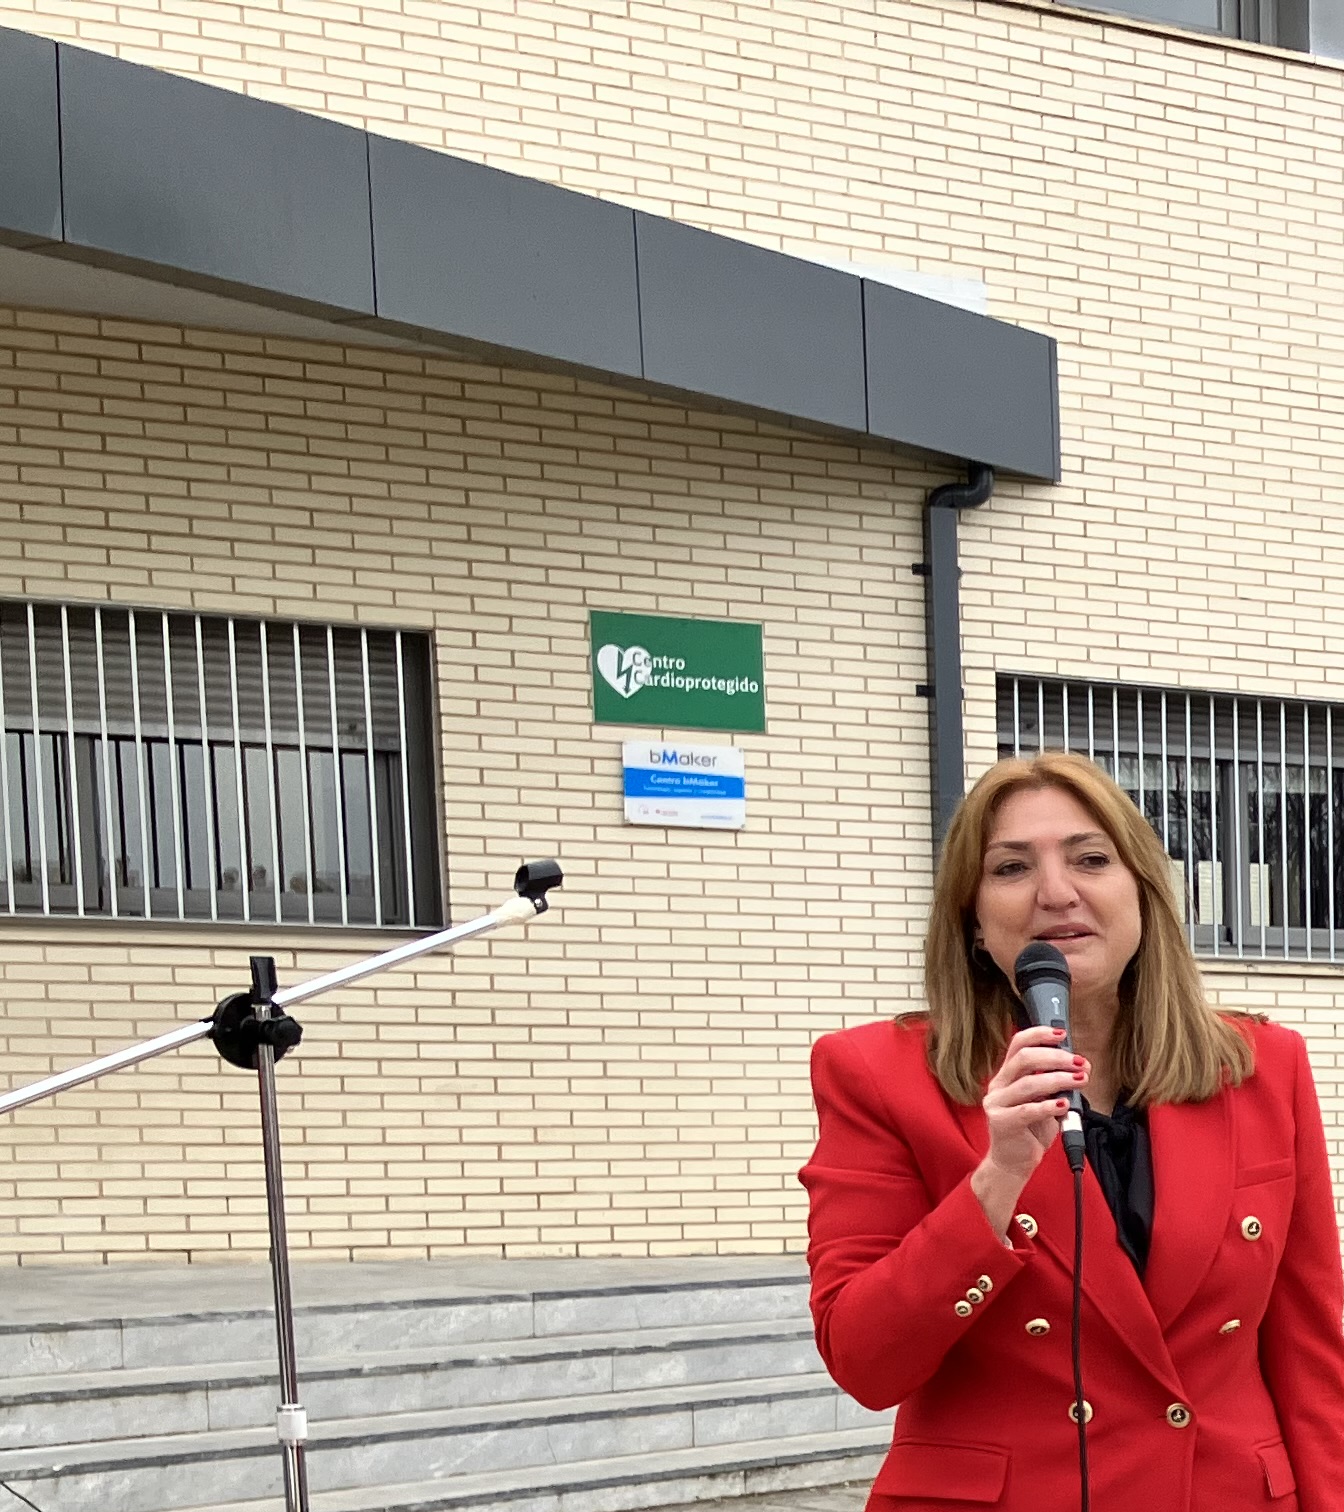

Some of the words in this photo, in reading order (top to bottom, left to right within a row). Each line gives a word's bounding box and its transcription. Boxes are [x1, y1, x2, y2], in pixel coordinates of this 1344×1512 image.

[632, 651, 686, 671] Centro
[634, 670, 759, 696] Cardioprotegido
[649, 749, 718, 768] bMaker
